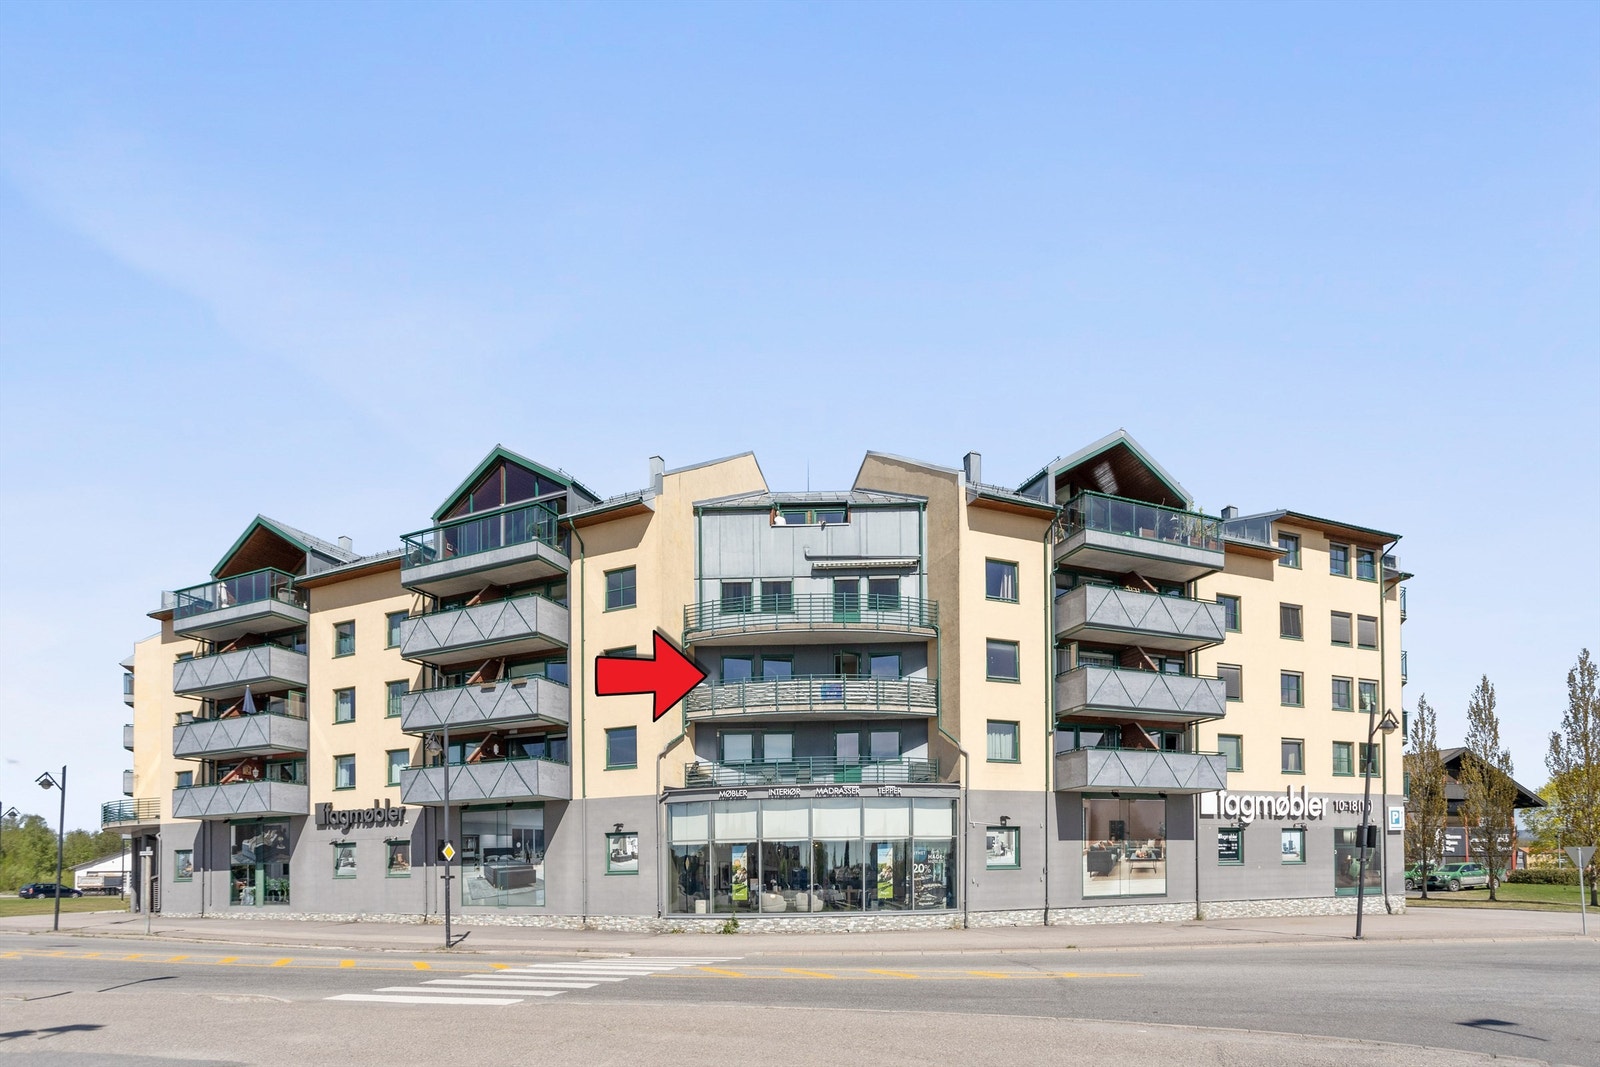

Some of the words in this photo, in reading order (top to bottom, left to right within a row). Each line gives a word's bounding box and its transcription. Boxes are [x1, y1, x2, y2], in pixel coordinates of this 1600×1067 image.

[719, 789, 748, 798] MØBLER
[768, 788, 801, 796] INTERIØR
[815, 787, 861, 795] MADRASSER
[878, 786, 902, 794] TEPPER
[324, 798, 405, 830] fagmøbler
[1219, 784, 1329, 823] fagmøbler
[1392, 811, 1399, 824] P
